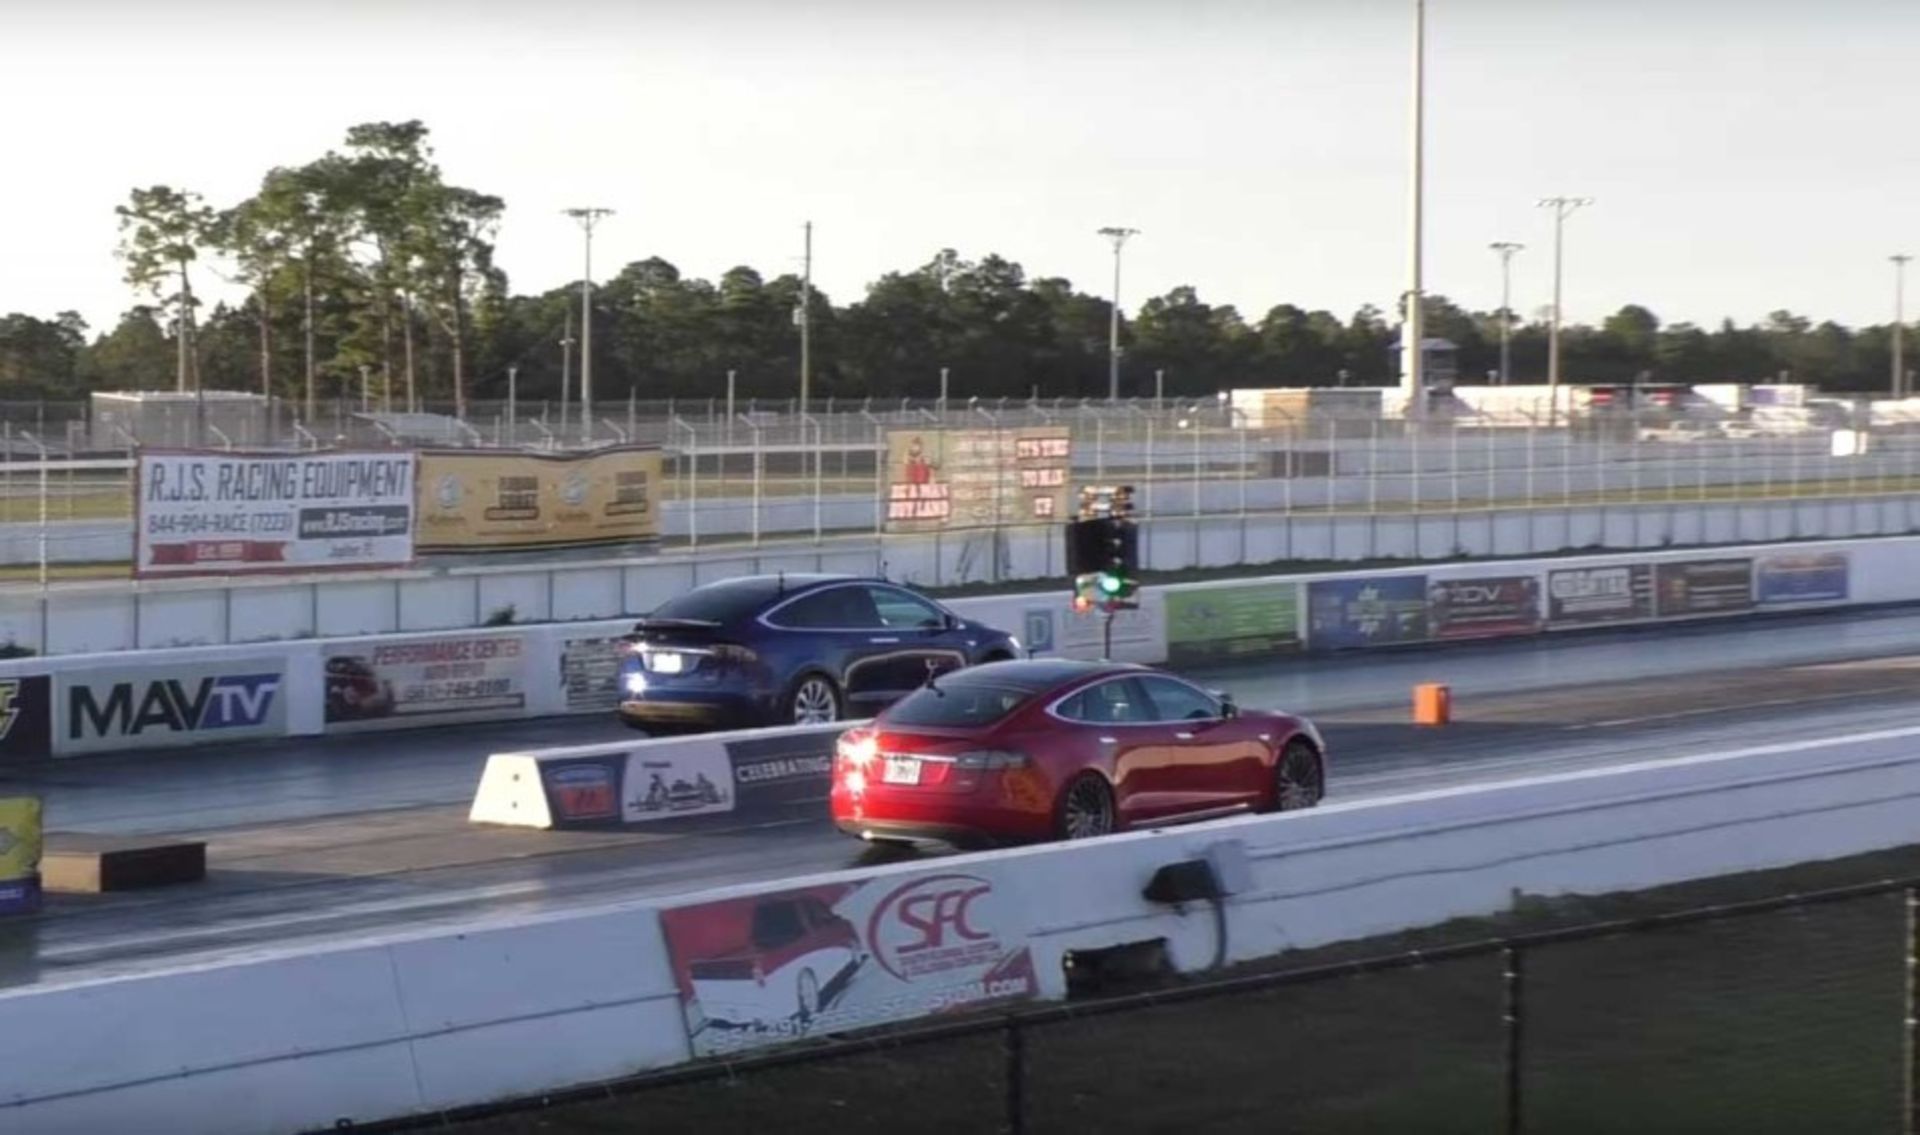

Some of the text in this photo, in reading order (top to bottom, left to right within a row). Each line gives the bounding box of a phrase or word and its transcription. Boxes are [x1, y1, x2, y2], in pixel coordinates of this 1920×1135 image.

[148, 459, 410, 501] R.J.S. RACING EQUIPMENT
[736, 756, 832, 782] CELEBRATING
[896, 885, 992, 953] SFC
